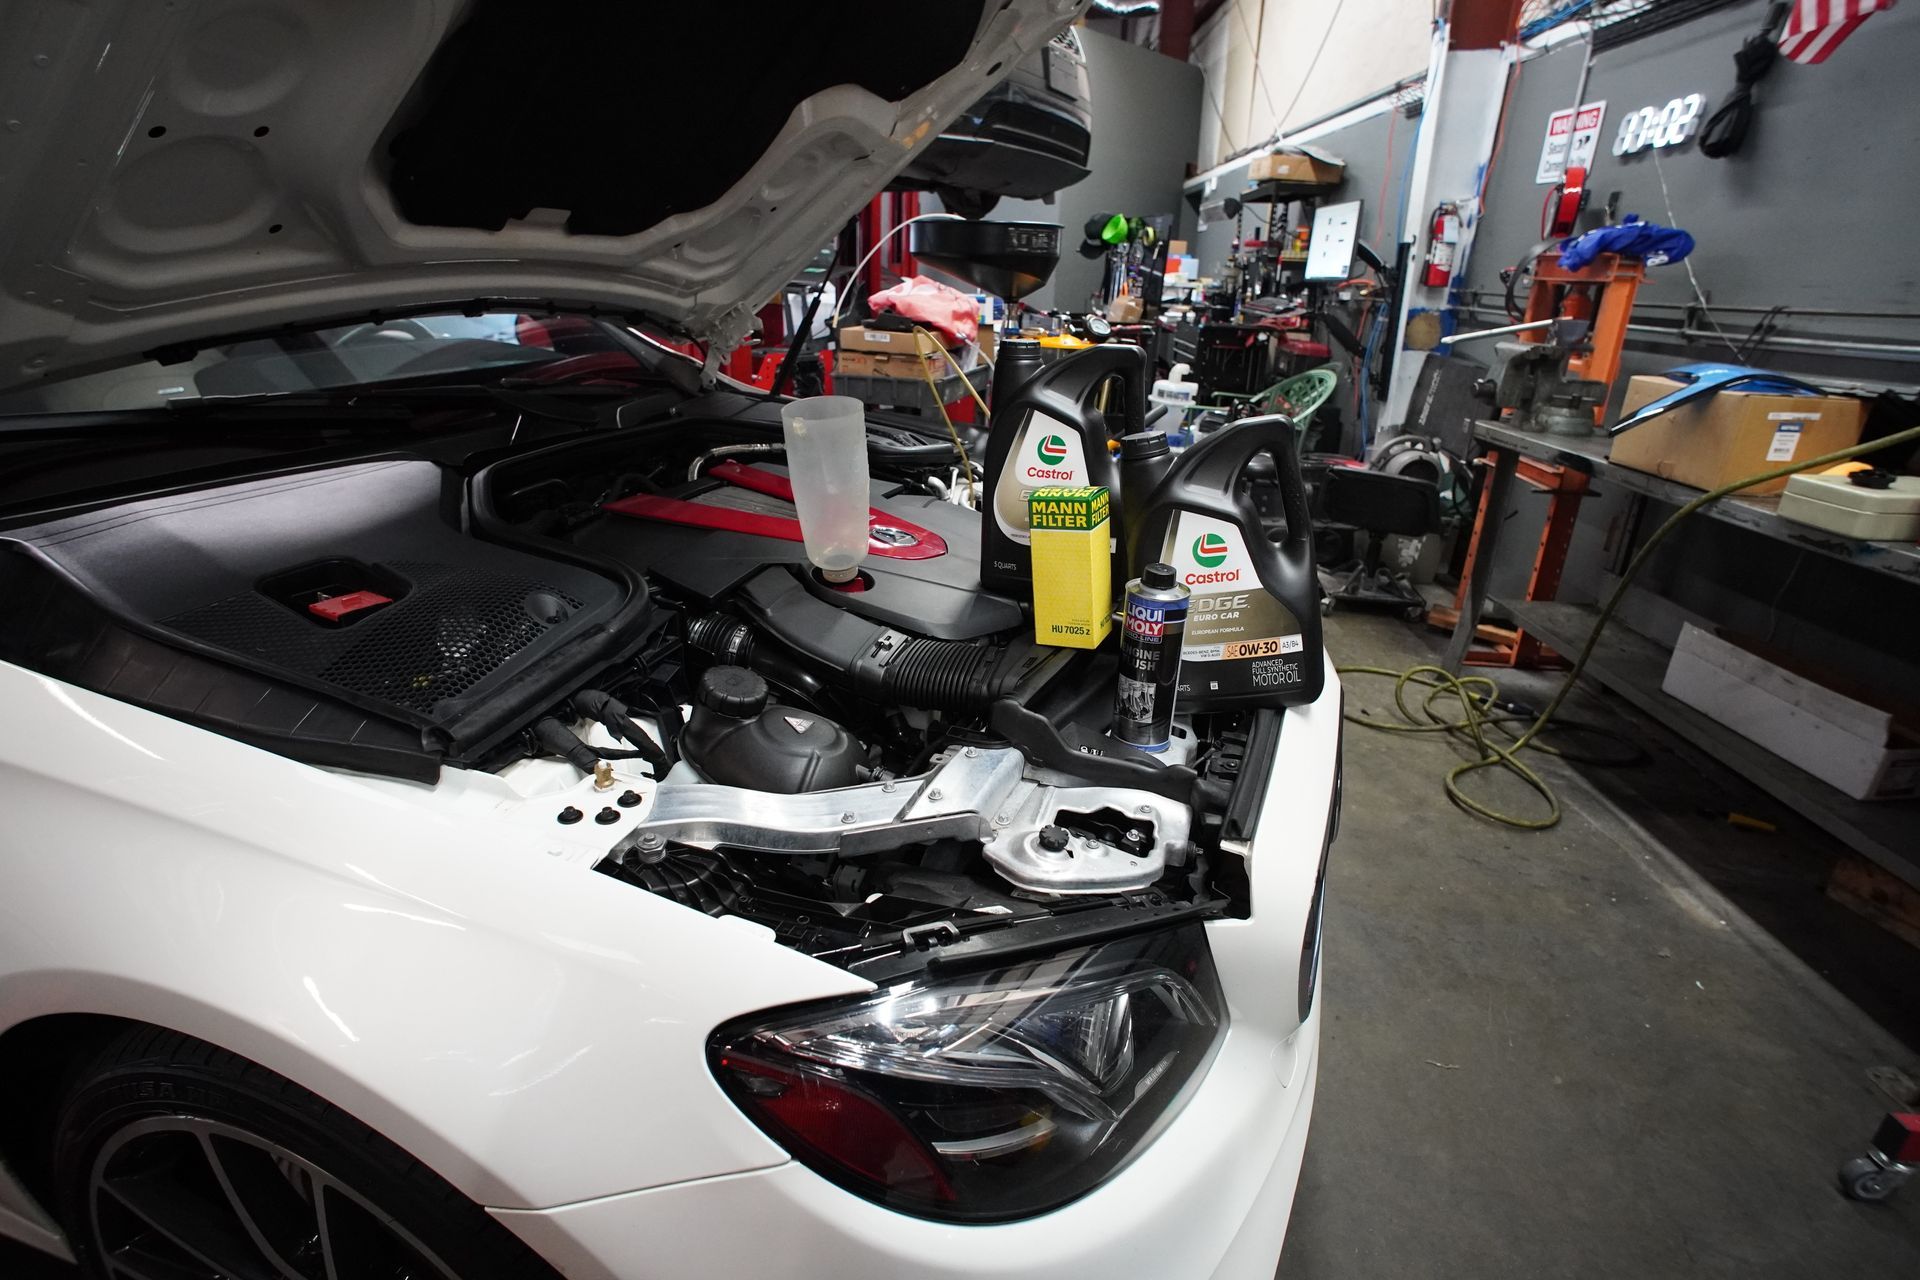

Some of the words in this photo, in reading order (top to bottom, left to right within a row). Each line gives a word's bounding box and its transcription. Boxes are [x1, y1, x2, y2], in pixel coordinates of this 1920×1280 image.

[1552, 109, 1599, 134] WANING
[1027, 467, 1073, 480] Castrol
[1032, 501, 1087, 514] MANN
[1091, 490, 1109, 513] MANN
[1032, 515, 1087, 527] FILTER
[1091, 504, 1109, 526] FILTER
[998, 561, 1017, 571] QUARTS
[1185, 568, 1240, 585] Castrol
[1127, 602, 1163, 622] LIQUI
[1193, 613, 1218, 621] EURO
[1220, 611, 1240, 619] CAR
[1051, 624, 1063, 633] HU
[1064, 626, 1085, 635] 7025
[1126, 615, 1162, 635] MOLY
[1192, 628, 1219, 636] EUROPEAN
[1220, 626, 1245, 634] FORMULA
[1226, 644, 1238, 658] SAE
[1239, 641, 1278, 656] 0W-30
[1282, 640, 1299, 649] A3/B4
[1123, 645, 1160, 661] NGINE
[1252, 658, 1283, 668] ADVANCED
[1267, 662, 1298, 673] SYNTHETIC
[1253, 672, 1285, 686] MOTOR
[1286, 670, 1302, 683] OIL
[1177, 684, 1191, 692] ARTS
